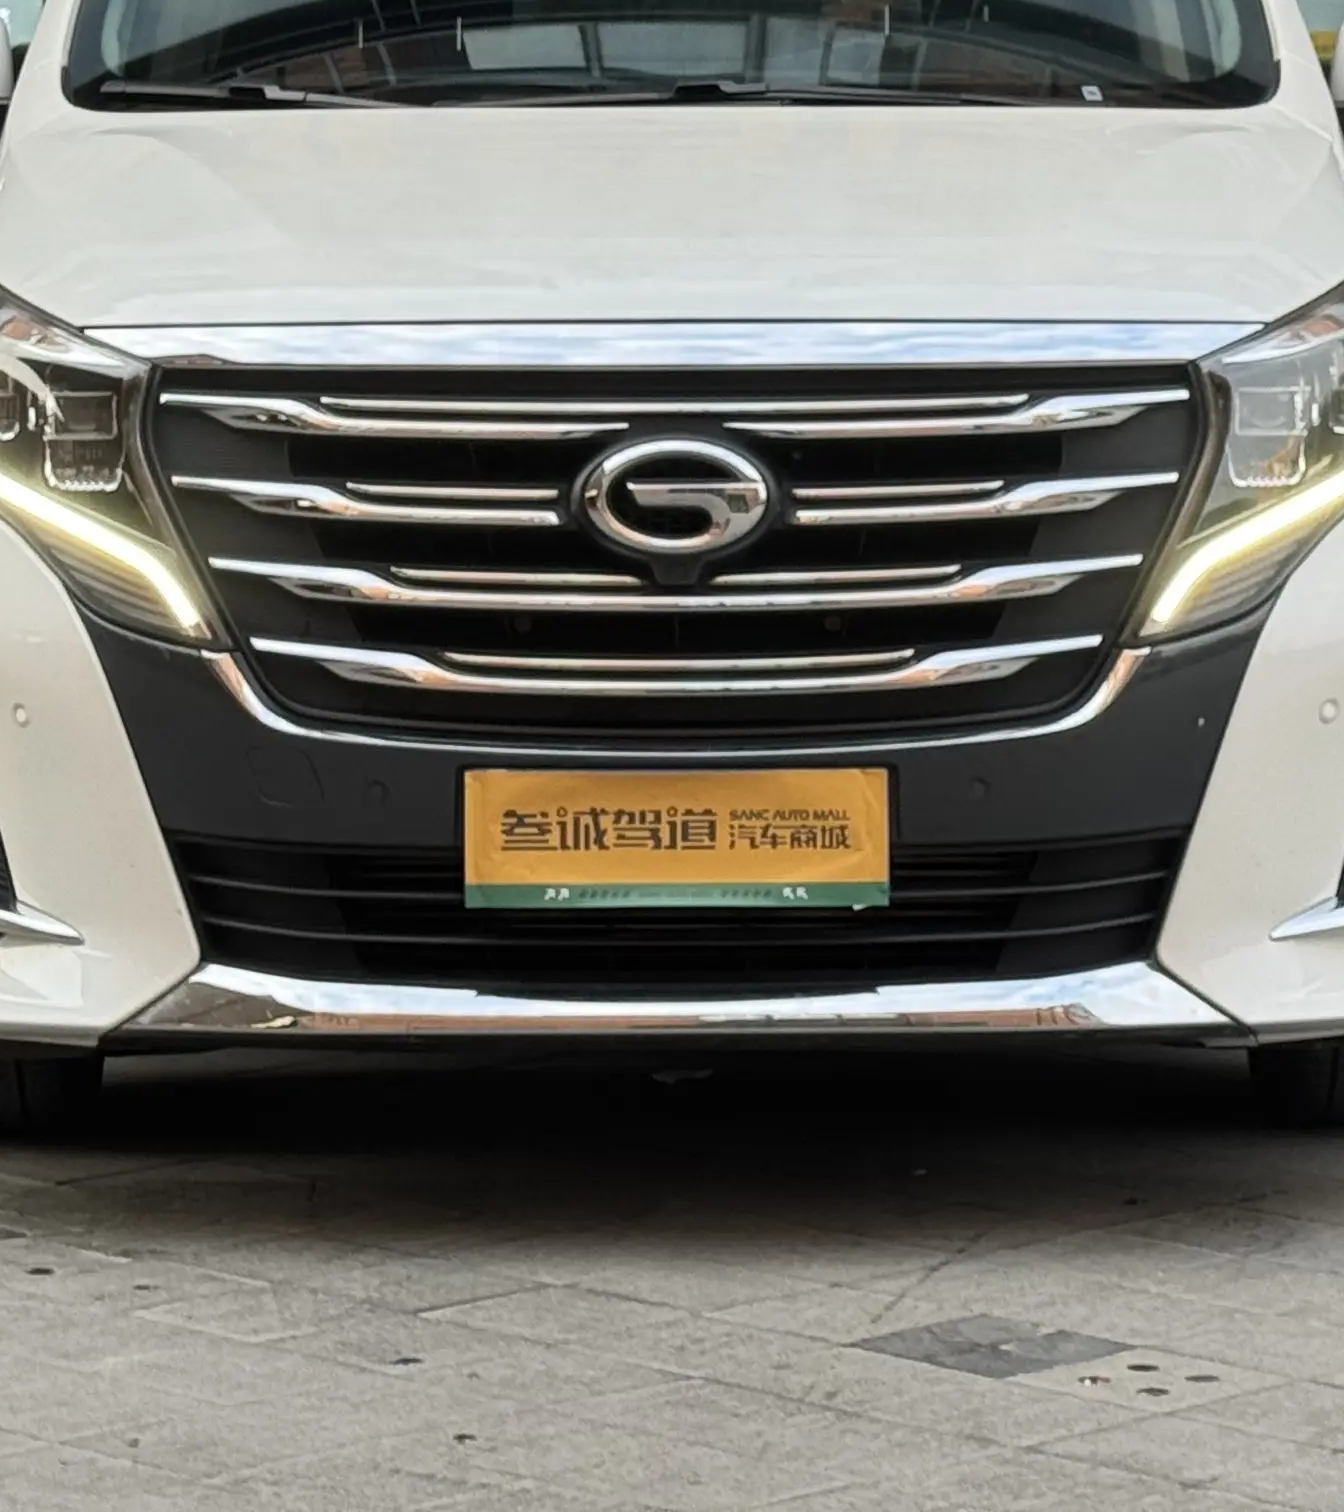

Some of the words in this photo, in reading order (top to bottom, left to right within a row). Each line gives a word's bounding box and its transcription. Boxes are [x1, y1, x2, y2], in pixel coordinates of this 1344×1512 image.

[772, 808, 812, 821] AUTO
[813, 808, 851, 821] MALL
[500, 806, 717, 851] 叁诚驾道
[728, 823, 852, 850] 汽车商城
